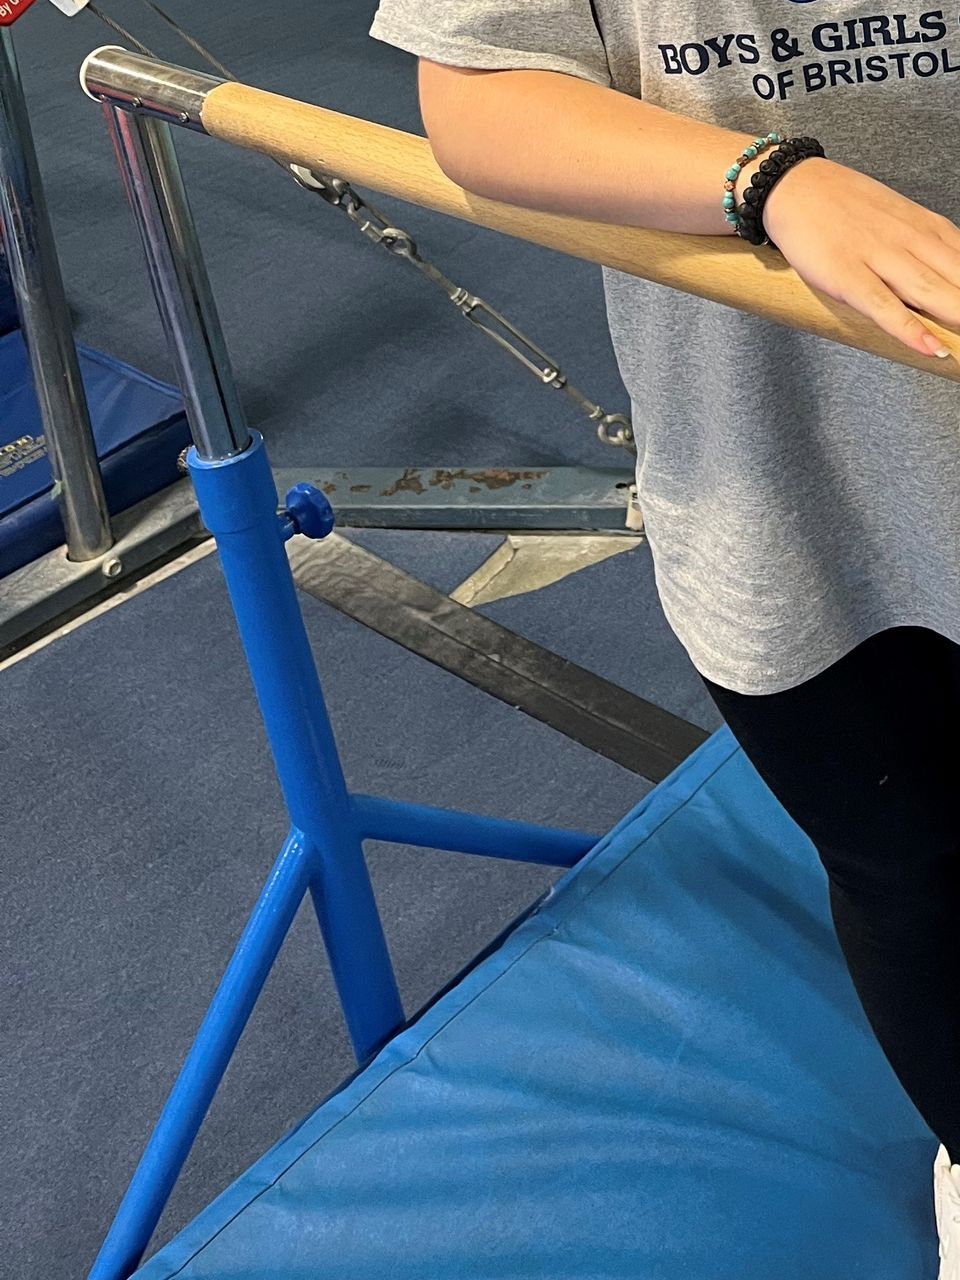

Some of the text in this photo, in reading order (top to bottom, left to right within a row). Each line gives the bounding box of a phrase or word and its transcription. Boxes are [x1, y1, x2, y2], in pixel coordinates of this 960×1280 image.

[657, 33, 760, 76] BOYS
[771, 28, 804, 63] &
[811, 10, 948, 53] GIRLS
[752, 69, 795, 101] OF
